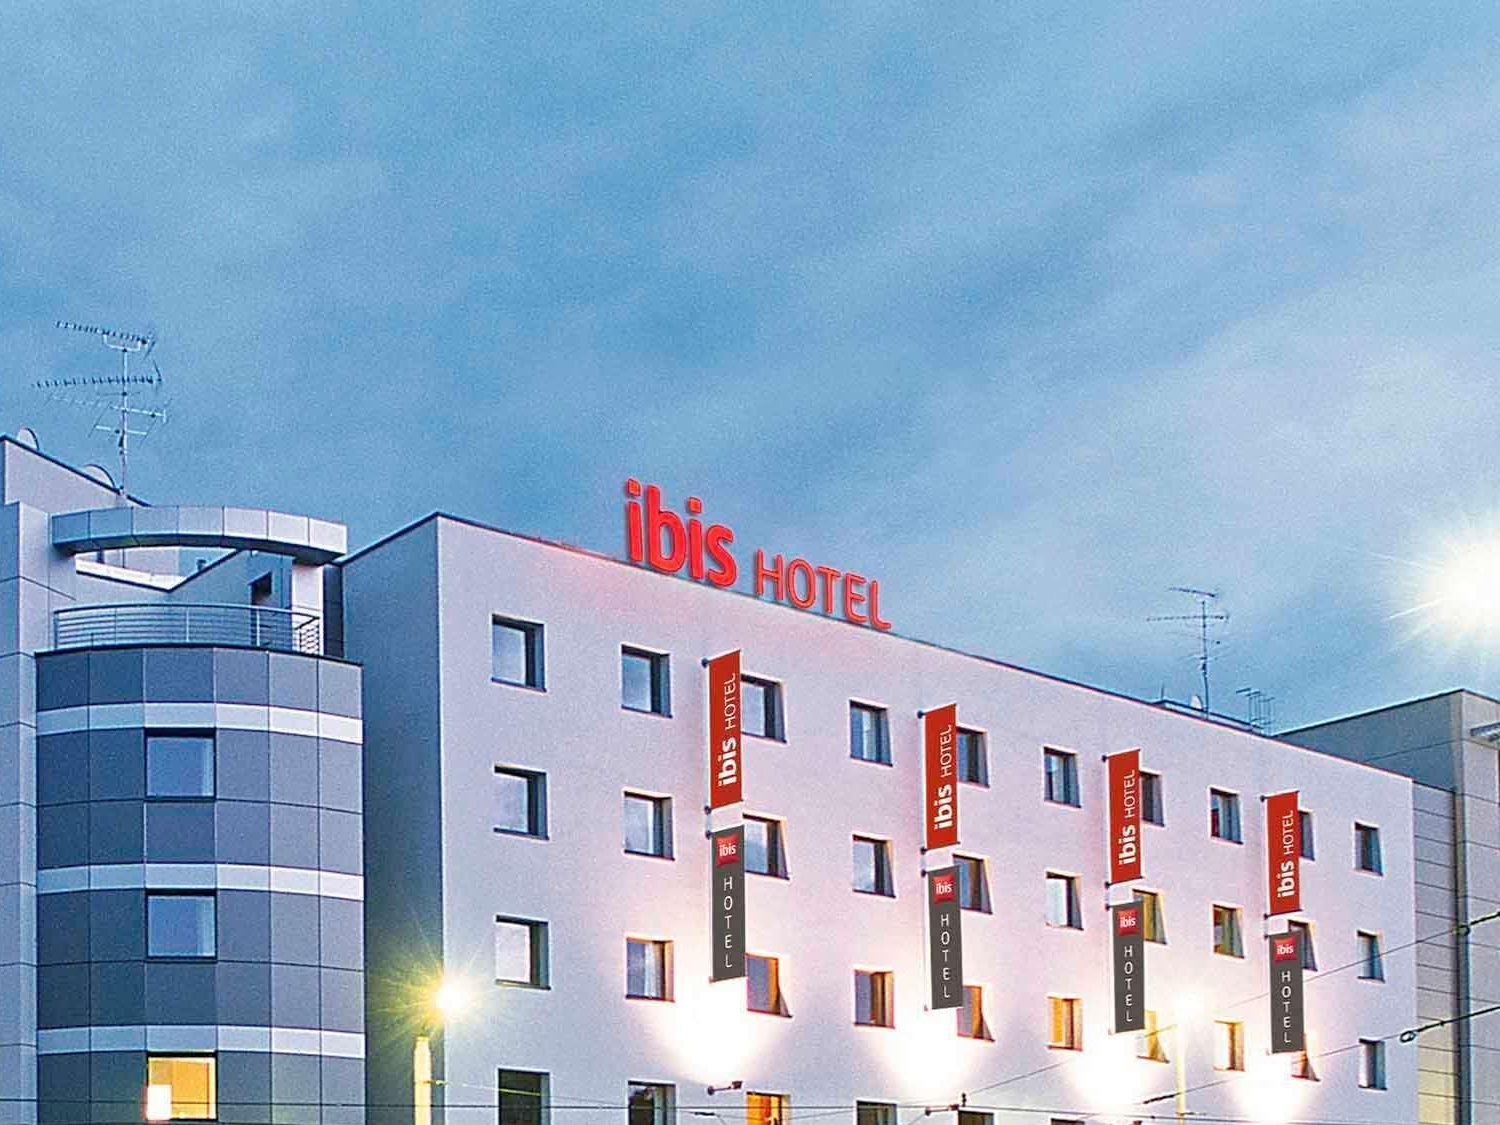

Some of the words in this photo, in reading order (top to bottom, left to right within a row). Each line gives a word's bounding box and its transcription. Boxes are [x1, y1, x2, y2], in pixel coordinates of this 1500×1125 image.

[626, 478, 737, 588] ibis
[756, 548, 892, 630] HOTEL
[724, 672, 736, 730] HOTEL
[718, 736, 737, 787] ibis
[940, 724, 952, 778] HOTEL
[934, 784, 953, 830] ibis
[1123, 769, 1136, 818] HOTEL
[719, 843, 737, 857] ibis
[1118, 824, 1136, 865] ibis
[1282, 810, 1295, 855] HOTEL
[935, 881, 953, 895] ibis
[1276, 860, 1295, 898] ibis
[723, 876, 733, 968] HOTEL
[1119, 916, 1137, 928] ibis
[940, 913, 950, 998] HOTEL
[1276, 944, 1294, 955] ibis
[1124, 945, 1133, 1022] HOTEL
[1281, 970, 1292, 1043] HOTEL
